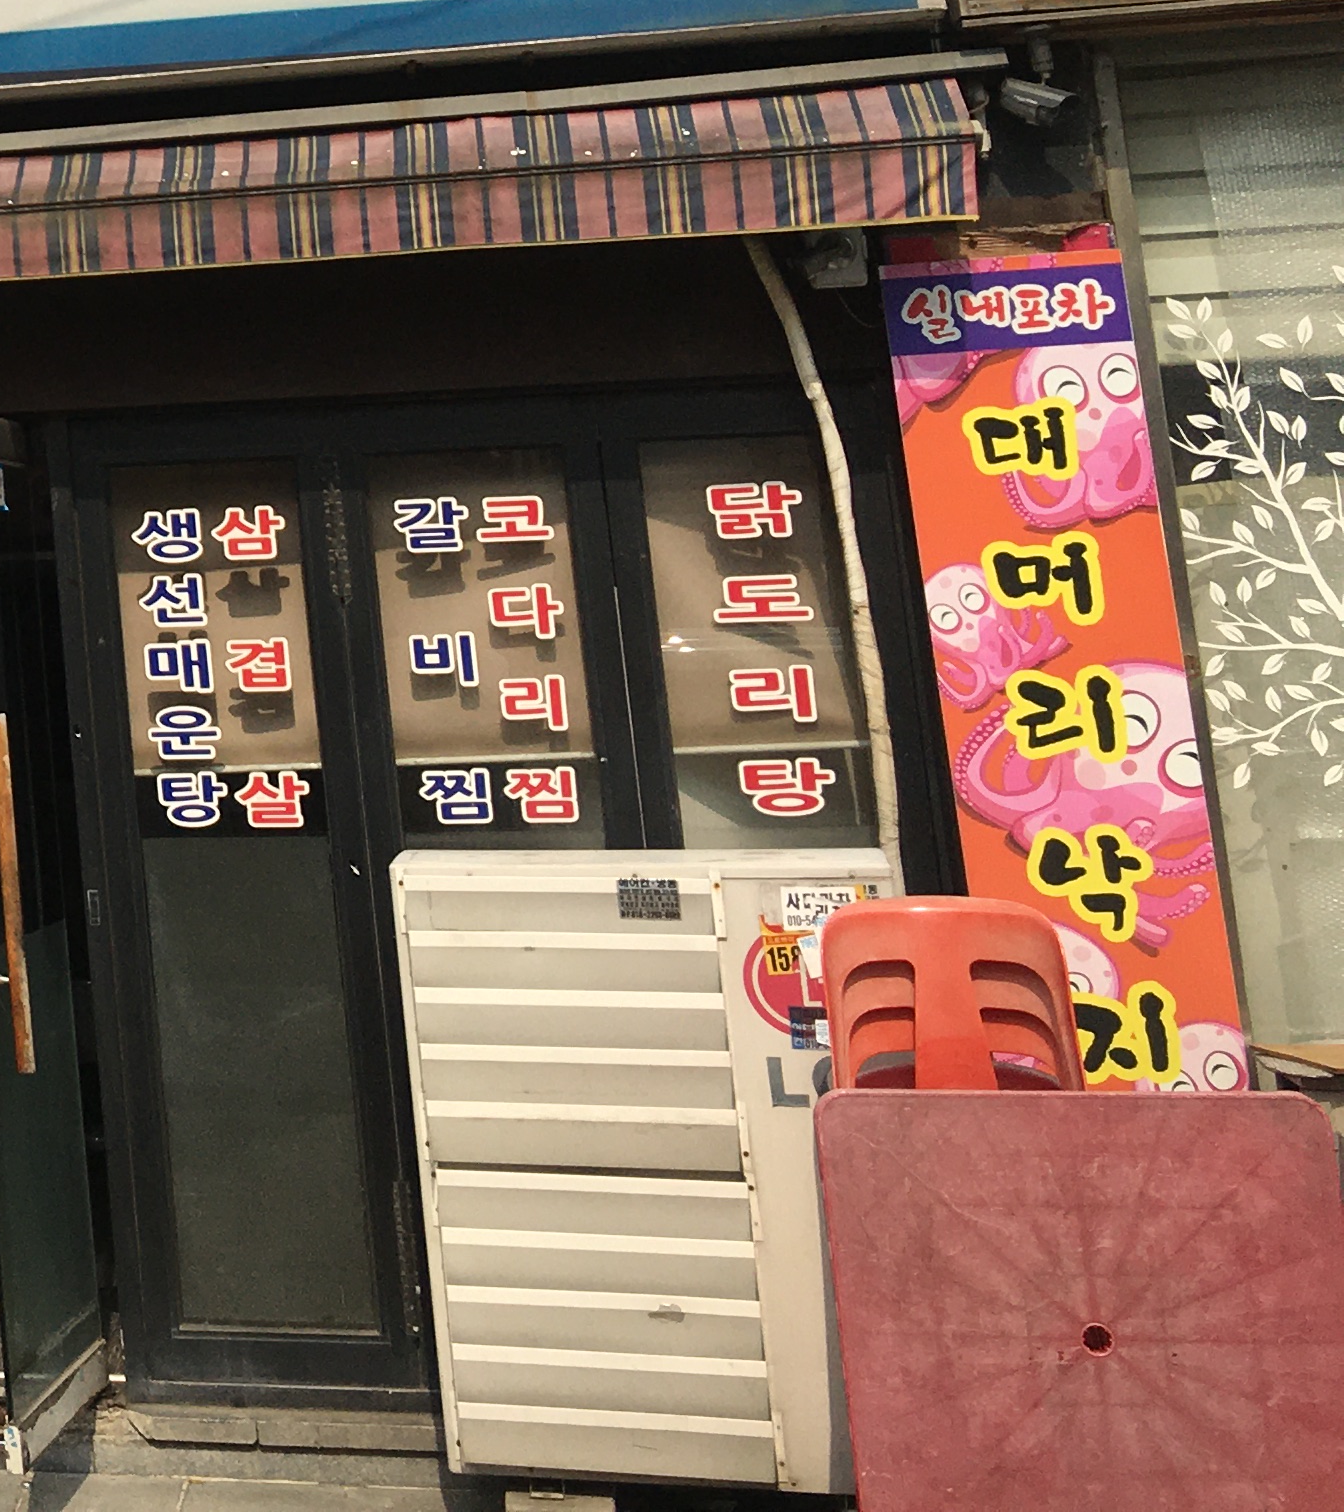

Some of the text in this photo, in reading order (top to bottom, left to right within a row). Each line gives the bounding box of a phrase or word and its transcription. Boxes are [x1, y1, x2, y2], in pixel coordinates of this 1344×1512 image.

[904, 281, 1113, 343] 실내포차
[133, 507, 226, 828] 생선매운탕
[213, 505, 309, 829] 삼겹살
[477, 495, 580, 824] 코다리찜
[706, 481, 835, 817] 닭도리탕
